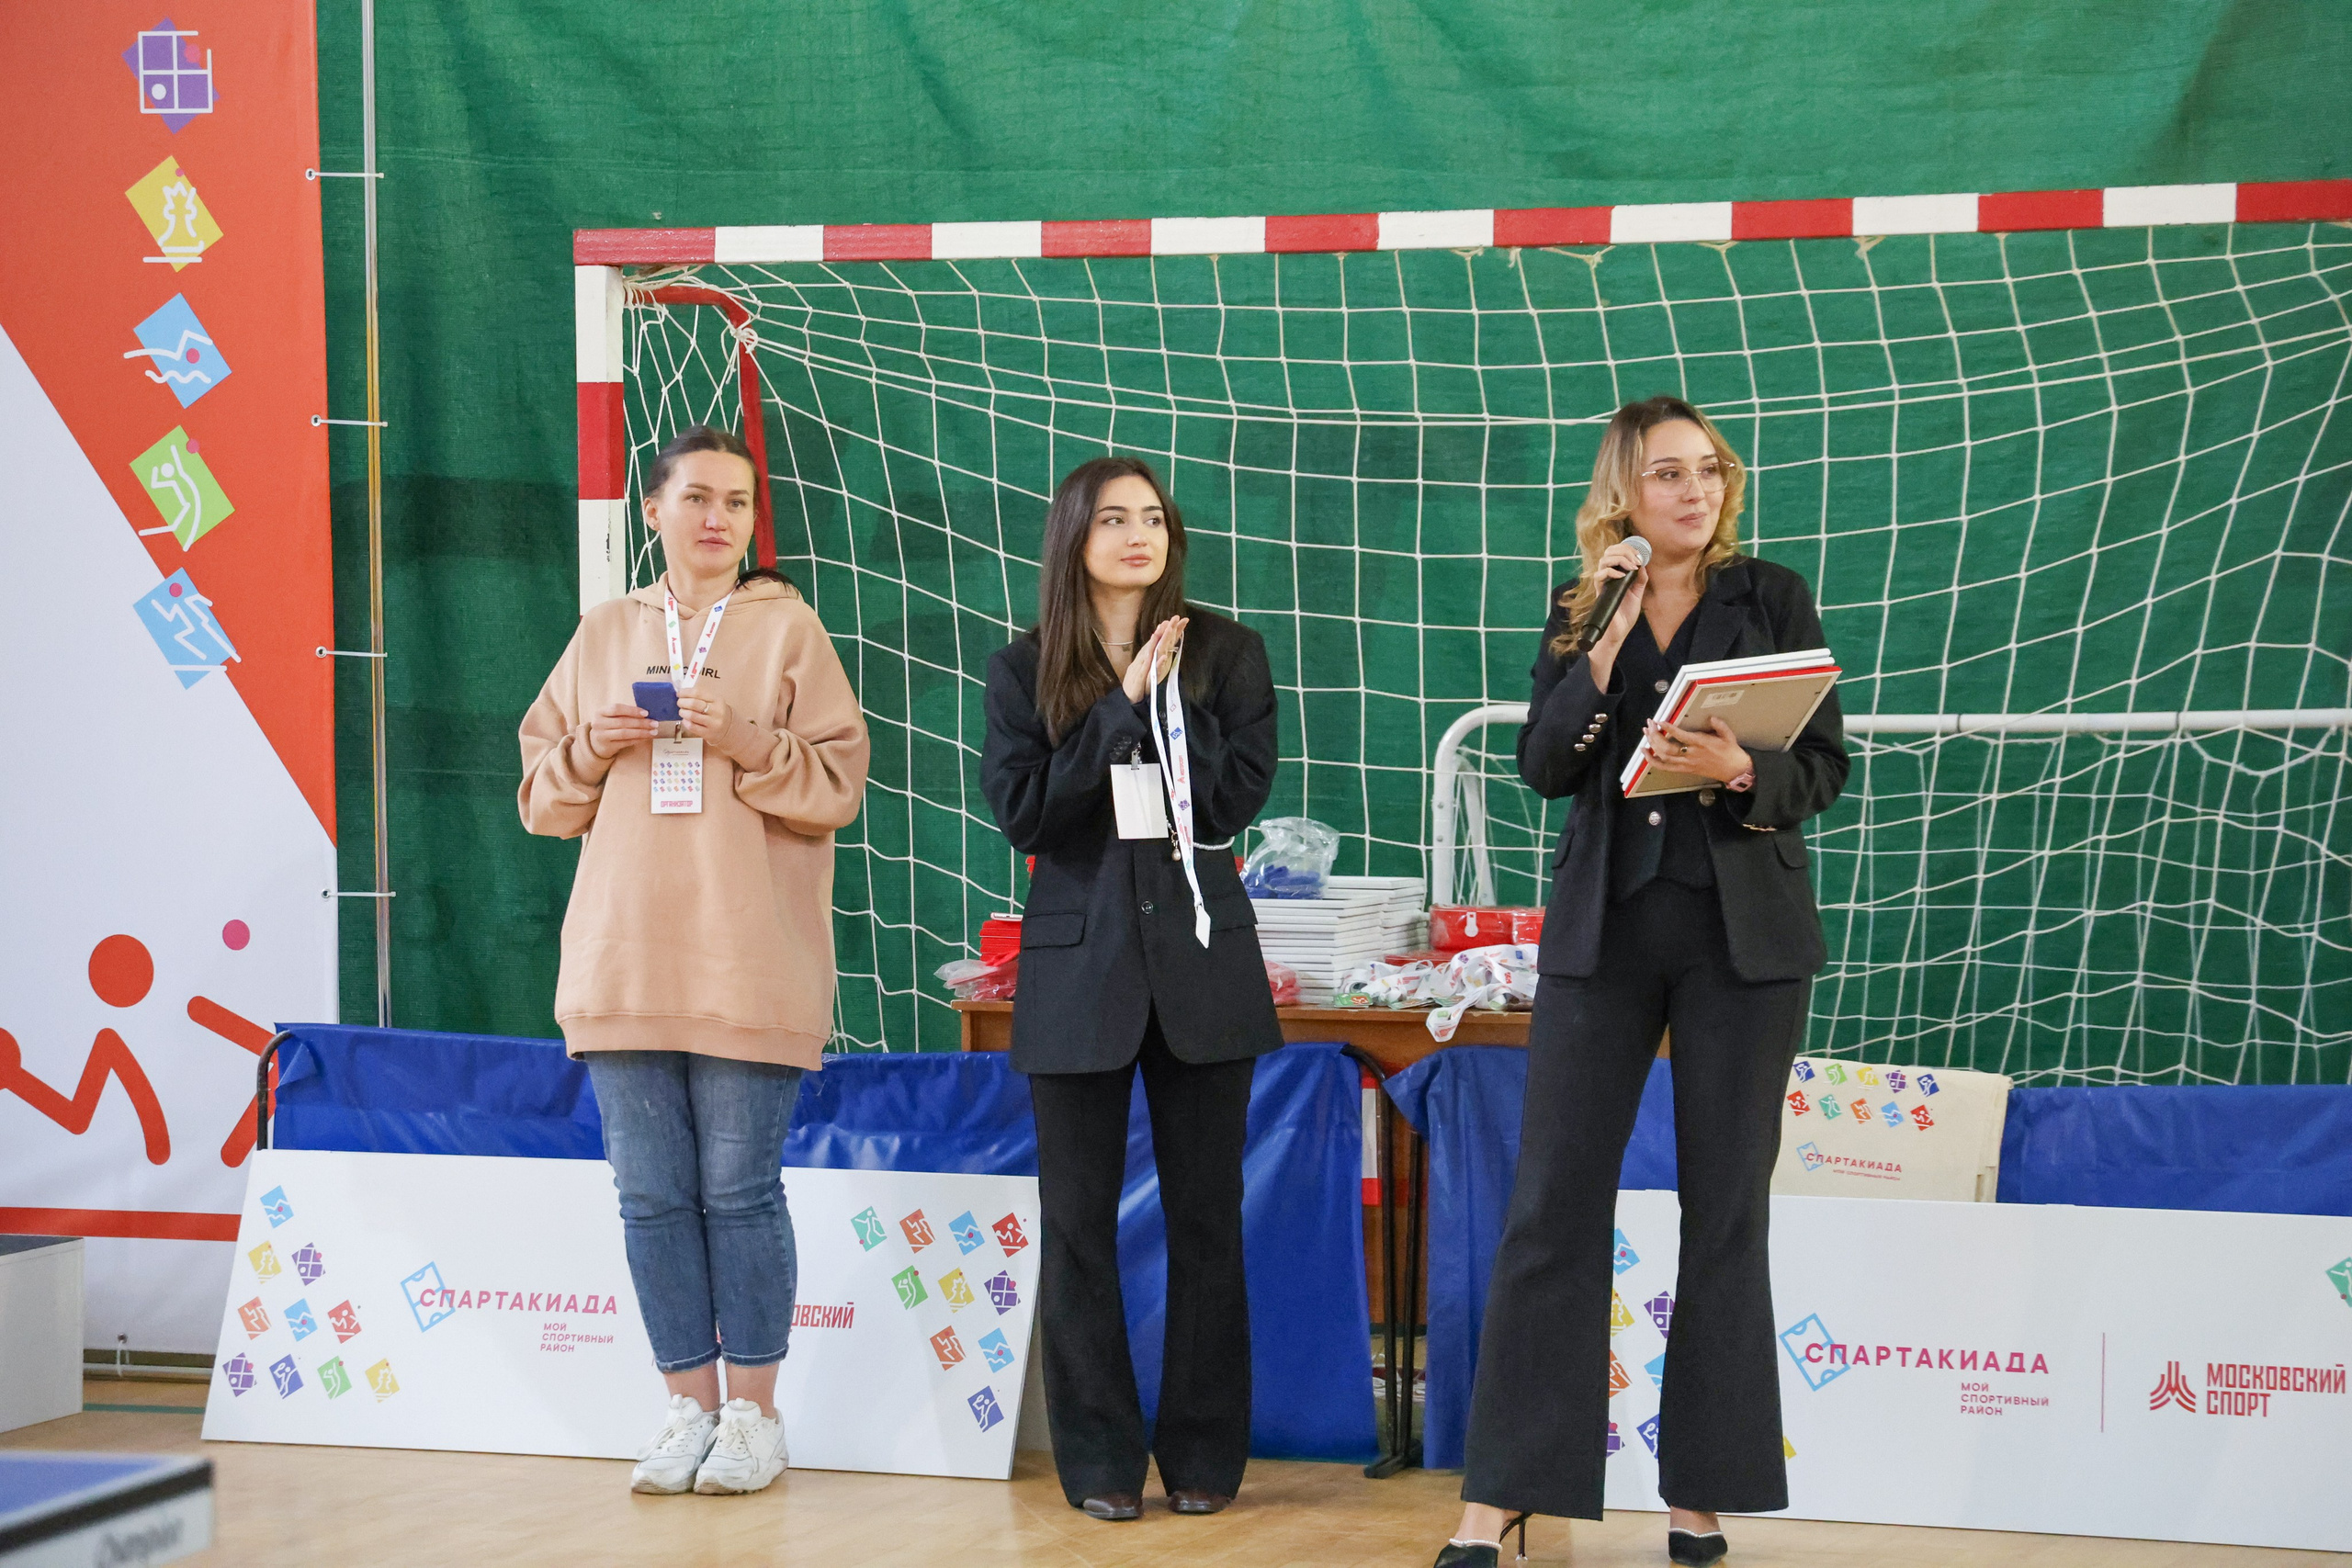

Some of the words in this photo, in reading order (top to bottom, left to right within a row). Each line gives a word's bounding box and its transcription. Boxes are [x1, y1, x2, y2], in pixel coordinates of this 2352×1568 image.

[1805, 1152, 1902, 1173] СПАРТАКИАДА
[419, 1288, 618, 1315] СПАРТАКИАДА
[790, 1301, 855, 1329] ОВСКИЙ
[543, 1322, 568, 1332] МОЙ
[542, 1333, 614, 1344] СПОРТИВНЫЙ
[540, 1342, 575, 1353] РАЙОН
[1804, 1342, 2050, 1374] СПАРТАКИАДА
[2206, 1362, 2346, 1394] МОСКОВСКИЙ
[1961, 1382, 1989, 1392] МОЙ
[1961, 1393, 2050, 1407] СПОРТИВНЫЙ
[2206, 1390, 2271, 1417] СПОРТ
[1961, 1404, 2003, 1416] РАЙОН
